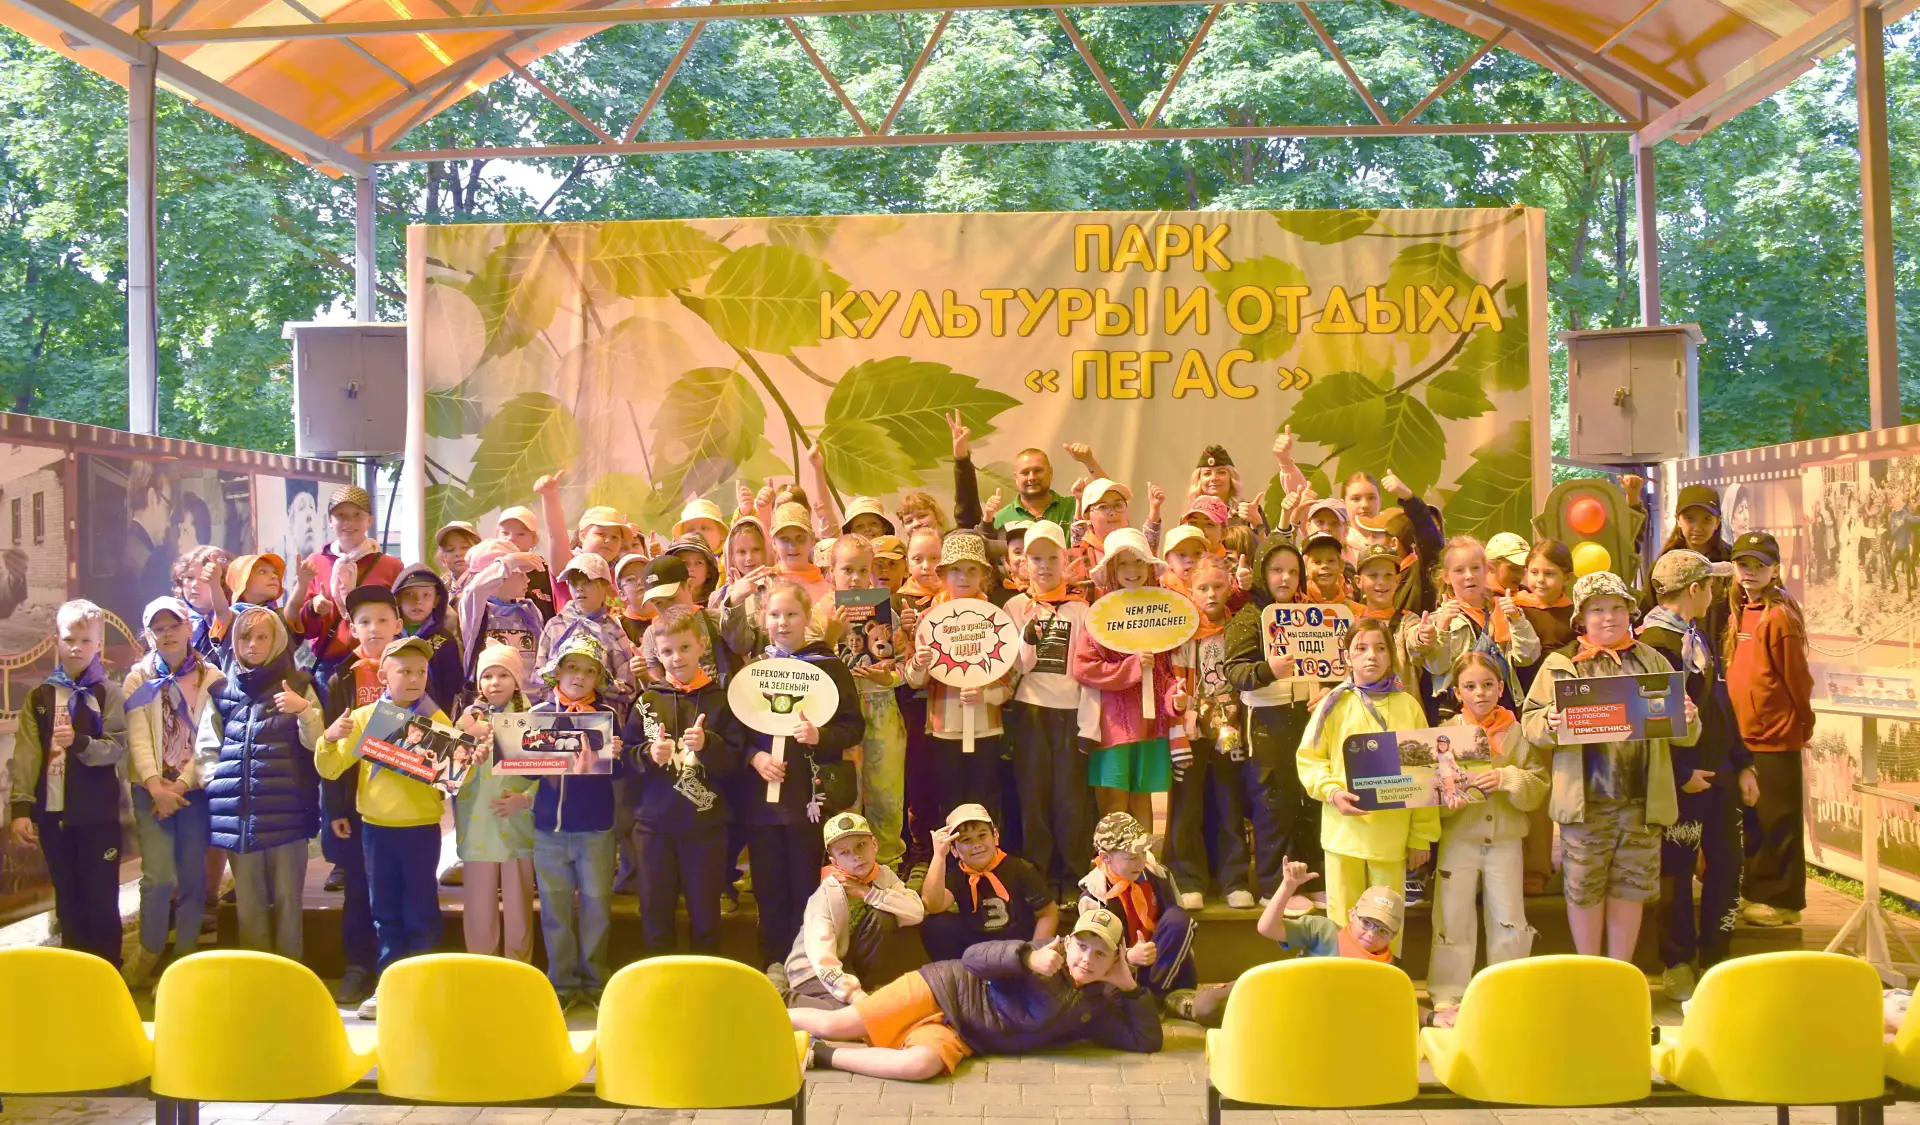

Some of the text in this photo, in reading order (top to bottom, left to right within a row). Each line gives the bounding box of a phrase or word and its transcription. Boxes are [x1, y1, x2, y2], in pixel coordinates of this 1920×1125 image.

[1073, 223, 1231, 272] ПАРК
[819, 284, 1504, 340] КУЛЬТУРЫ И ОТДЫХА
[1072, 349, 1258, 400] ПЕГАС
[1125, 603, 1171, 616] ЧЕМ ЯРЧЕ,
[1107, 616, 1187, 632] ТЕМ БЕЗОПАСНЕЕ!
[1298, 631, 1333, 639] СОБЛЮДАЕМ
[954, 642, 981, 657] ПДД!
[1298, 640, 1325, 654] ПДД!
[751, 668, 820, 682] ПЕРЕХОЖУ ТОЛЬКО
[759, 681, 810, 692] НА ЗЕЛЕНЫЙ!
[1567, 705, 1618, 714] БЕЗОПАСНОСТЬ
[1575, 724, 1631, 734] ПРИСТЕГНИСЬ!
[1354, 779, 1382, 787] ВКЛЮЧИ
[982, 897, 1009, 930] 3
